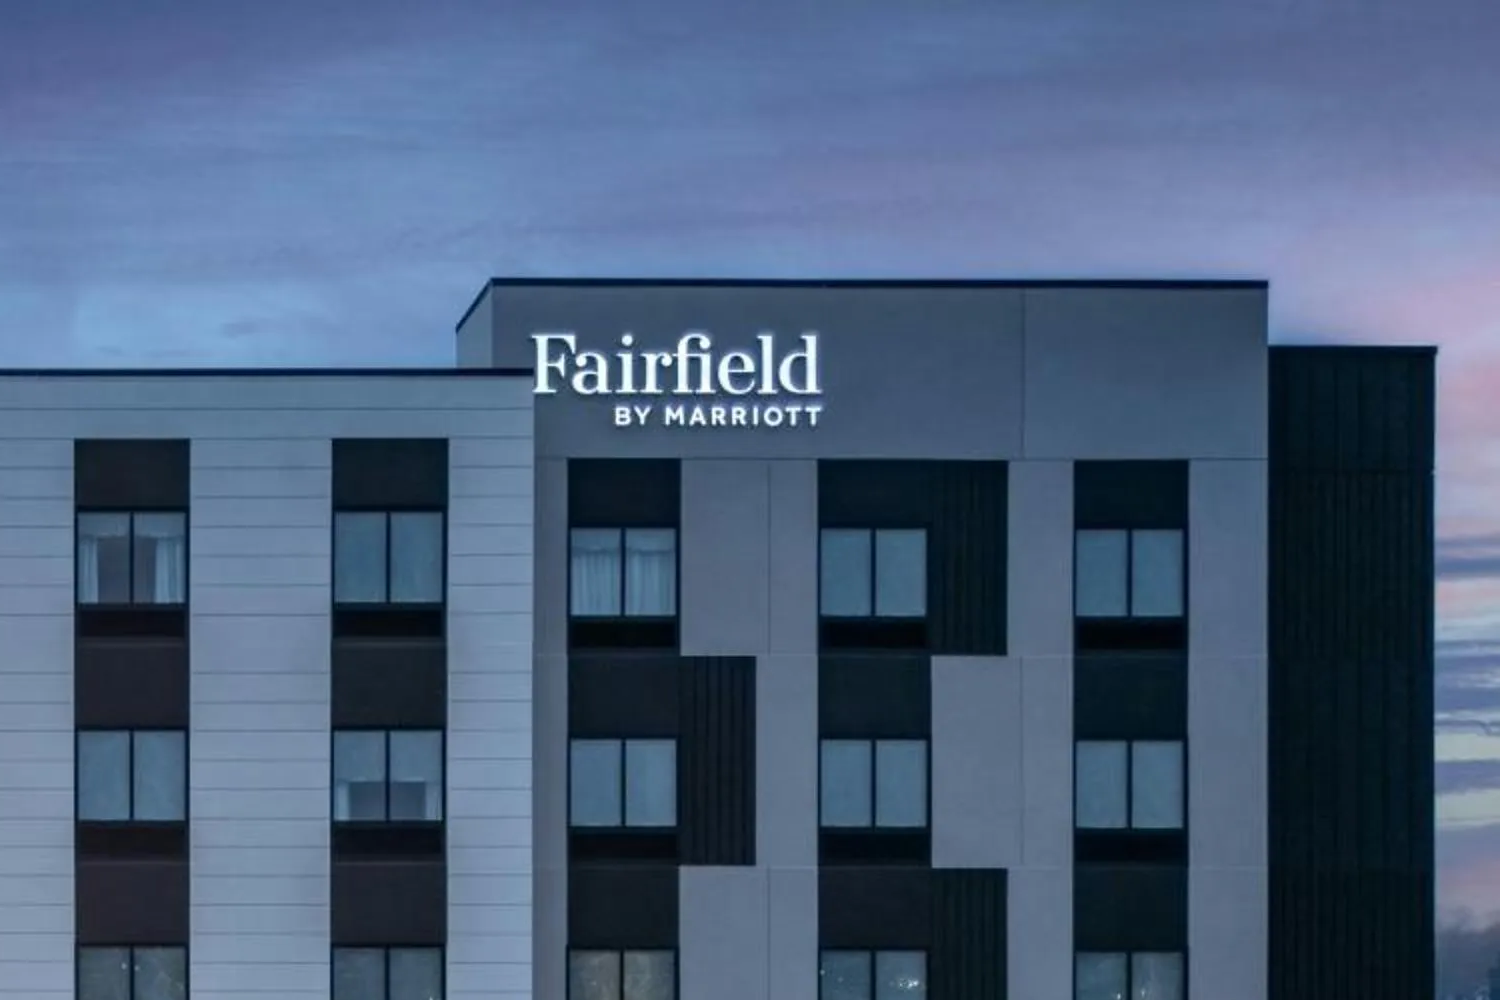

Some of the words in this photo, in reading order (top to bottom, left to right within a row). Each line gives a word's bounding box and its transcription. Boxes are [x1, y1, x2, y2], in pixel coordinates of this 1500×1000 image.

[531, 332, 822, 395] Fairfield
[614, 405, 652, 426] BY
[664, 405, 823, 427] MARRIOTT
